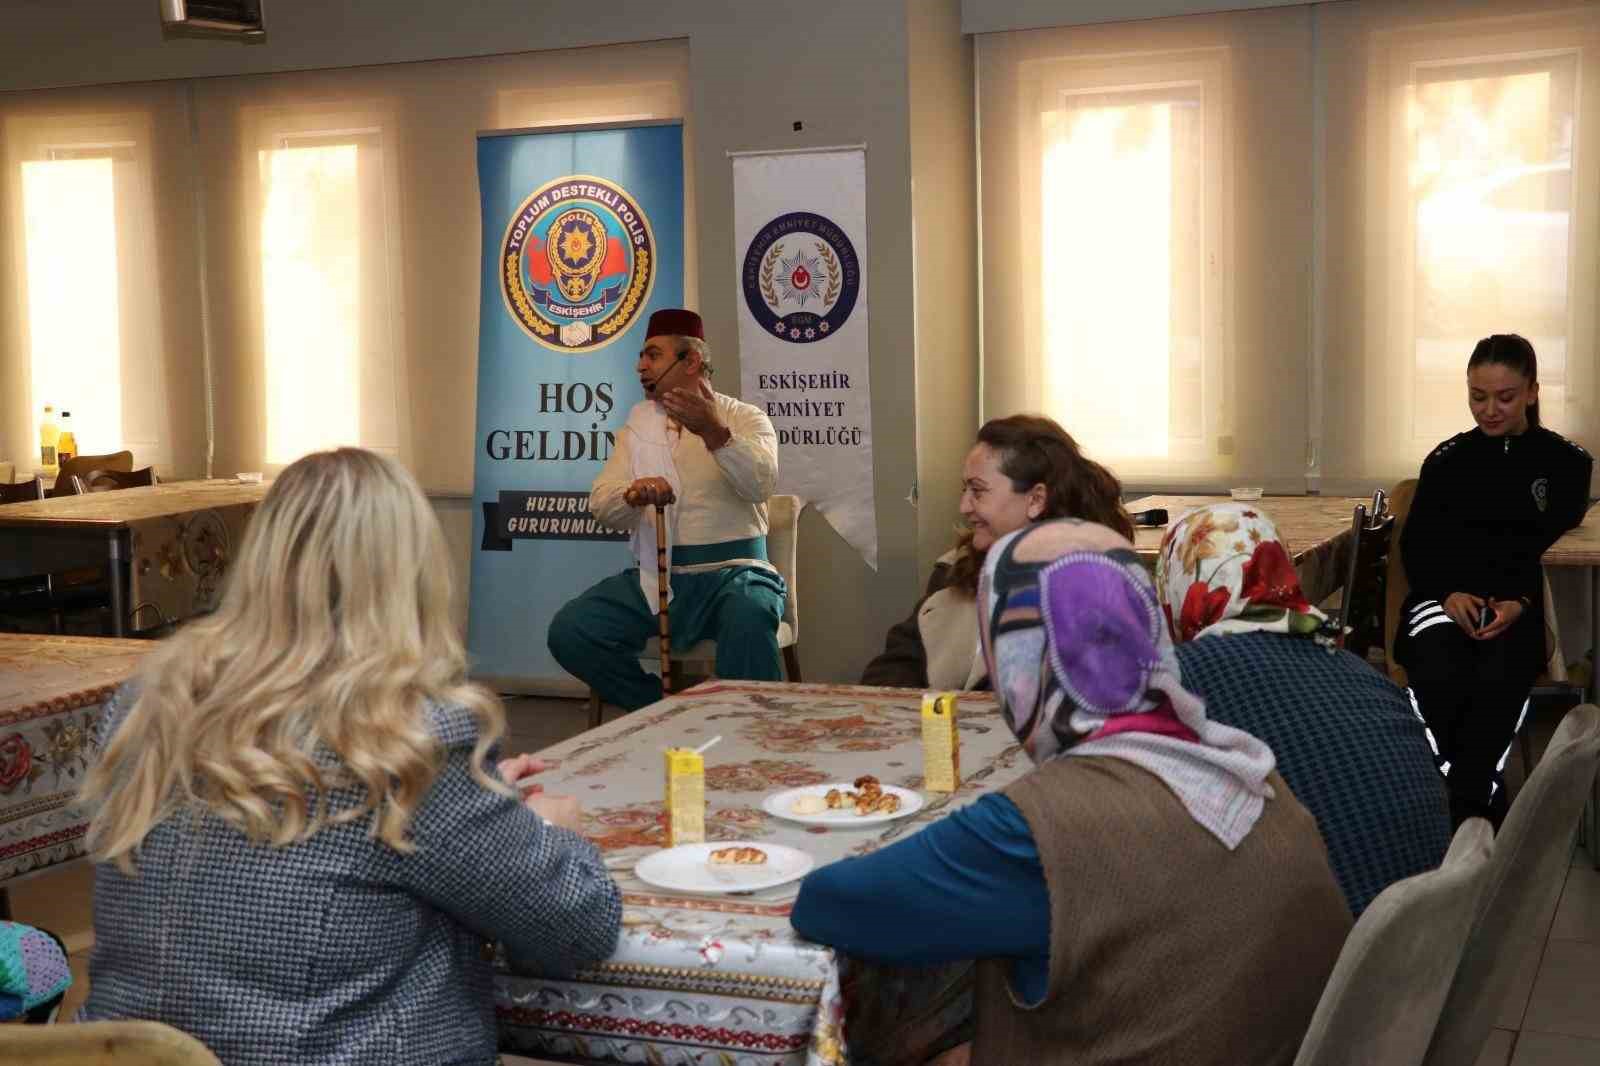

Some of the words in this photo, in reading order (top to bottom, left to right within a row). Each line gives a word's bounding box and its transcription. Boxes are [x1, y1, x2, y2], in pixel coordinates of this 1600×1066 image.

[510, 195, 550, 249] TOPLUM
[552, 184, 618, 206] DESTEKLİ
[617, 204, 645, 246] POLİS
[561, 213, 593, 227] POLİS
[549, 302, 604, 318] ESKİŞEHİR
[759, 370, 850, 393] ESKİŞEHİR
[538, 382, 614, 421] HOŞ
[767, 398, 845, 417] EMNİYET
[486, 422, 616, 461] GELDİN
[776, 426, 863, 446] DÜRLÜĞÜ
[526, 496, 592, 513] HUZURU
